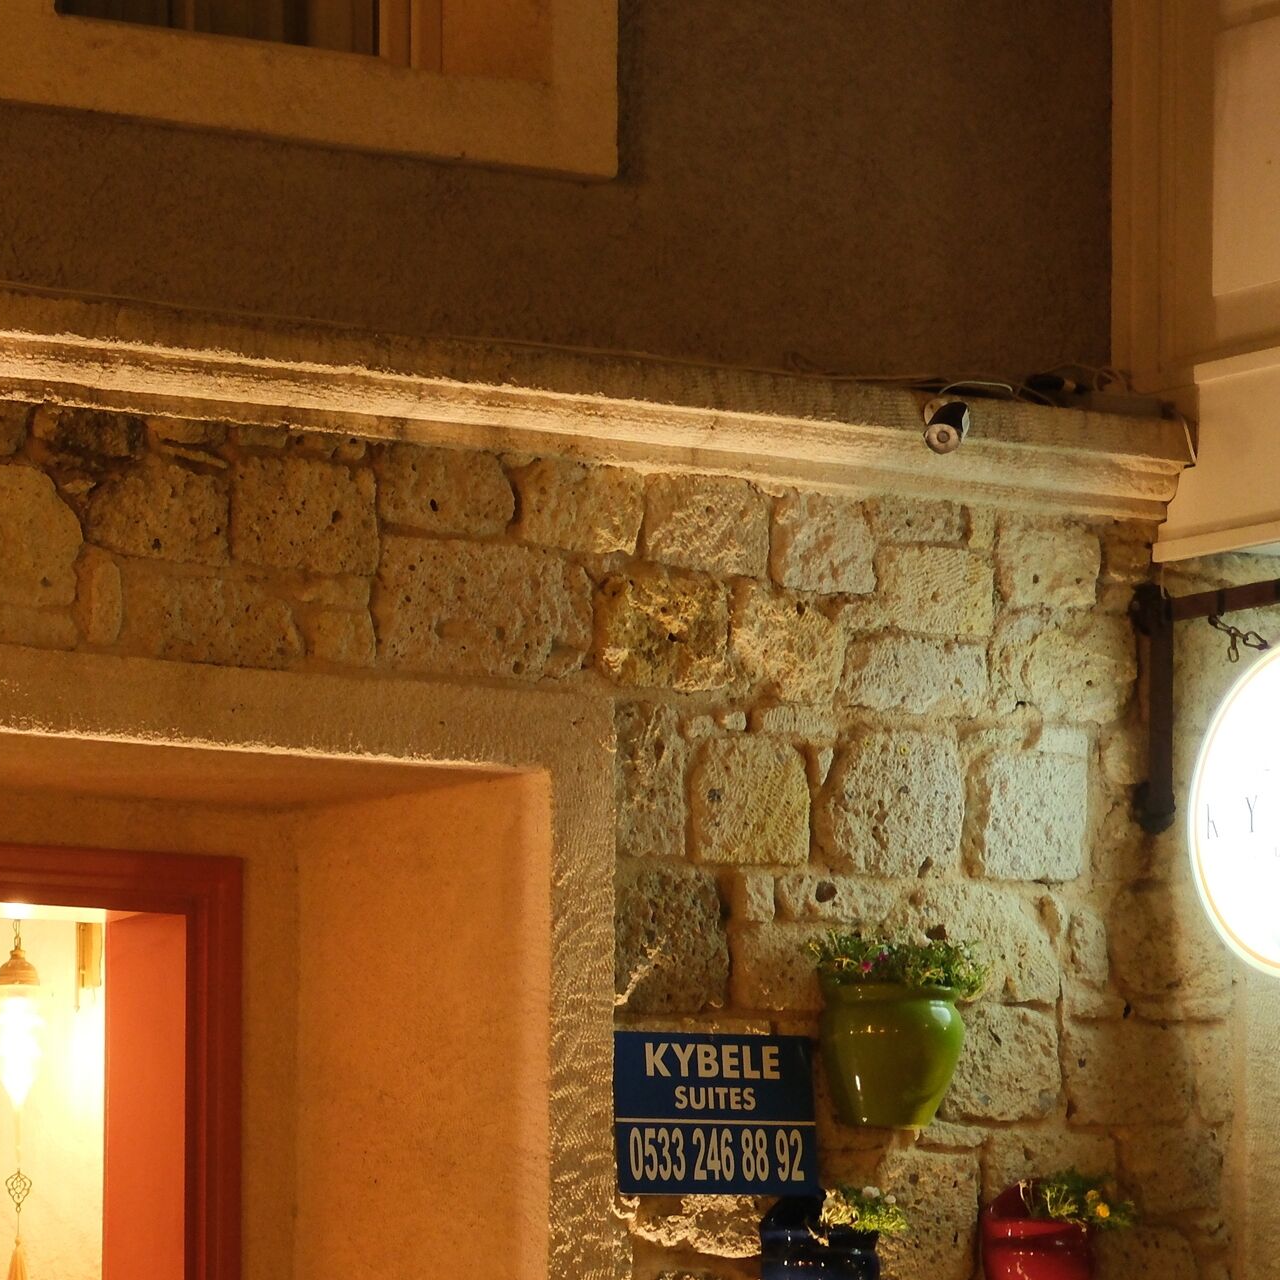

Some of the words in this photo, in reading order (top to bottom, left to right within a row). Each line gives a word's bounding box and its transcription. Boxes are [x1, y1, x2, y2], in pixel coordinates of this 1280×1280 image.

[644, 1041, 781, 1080] KYBELE
[674, 1085, 757, 1111] SUITES
[629, 1126, 687, 1182] 0533
[692, 1127, 736, 1182] 246
[740, 1127, 770, 1182] 88
[775, 1128, 806, 1182] 92
